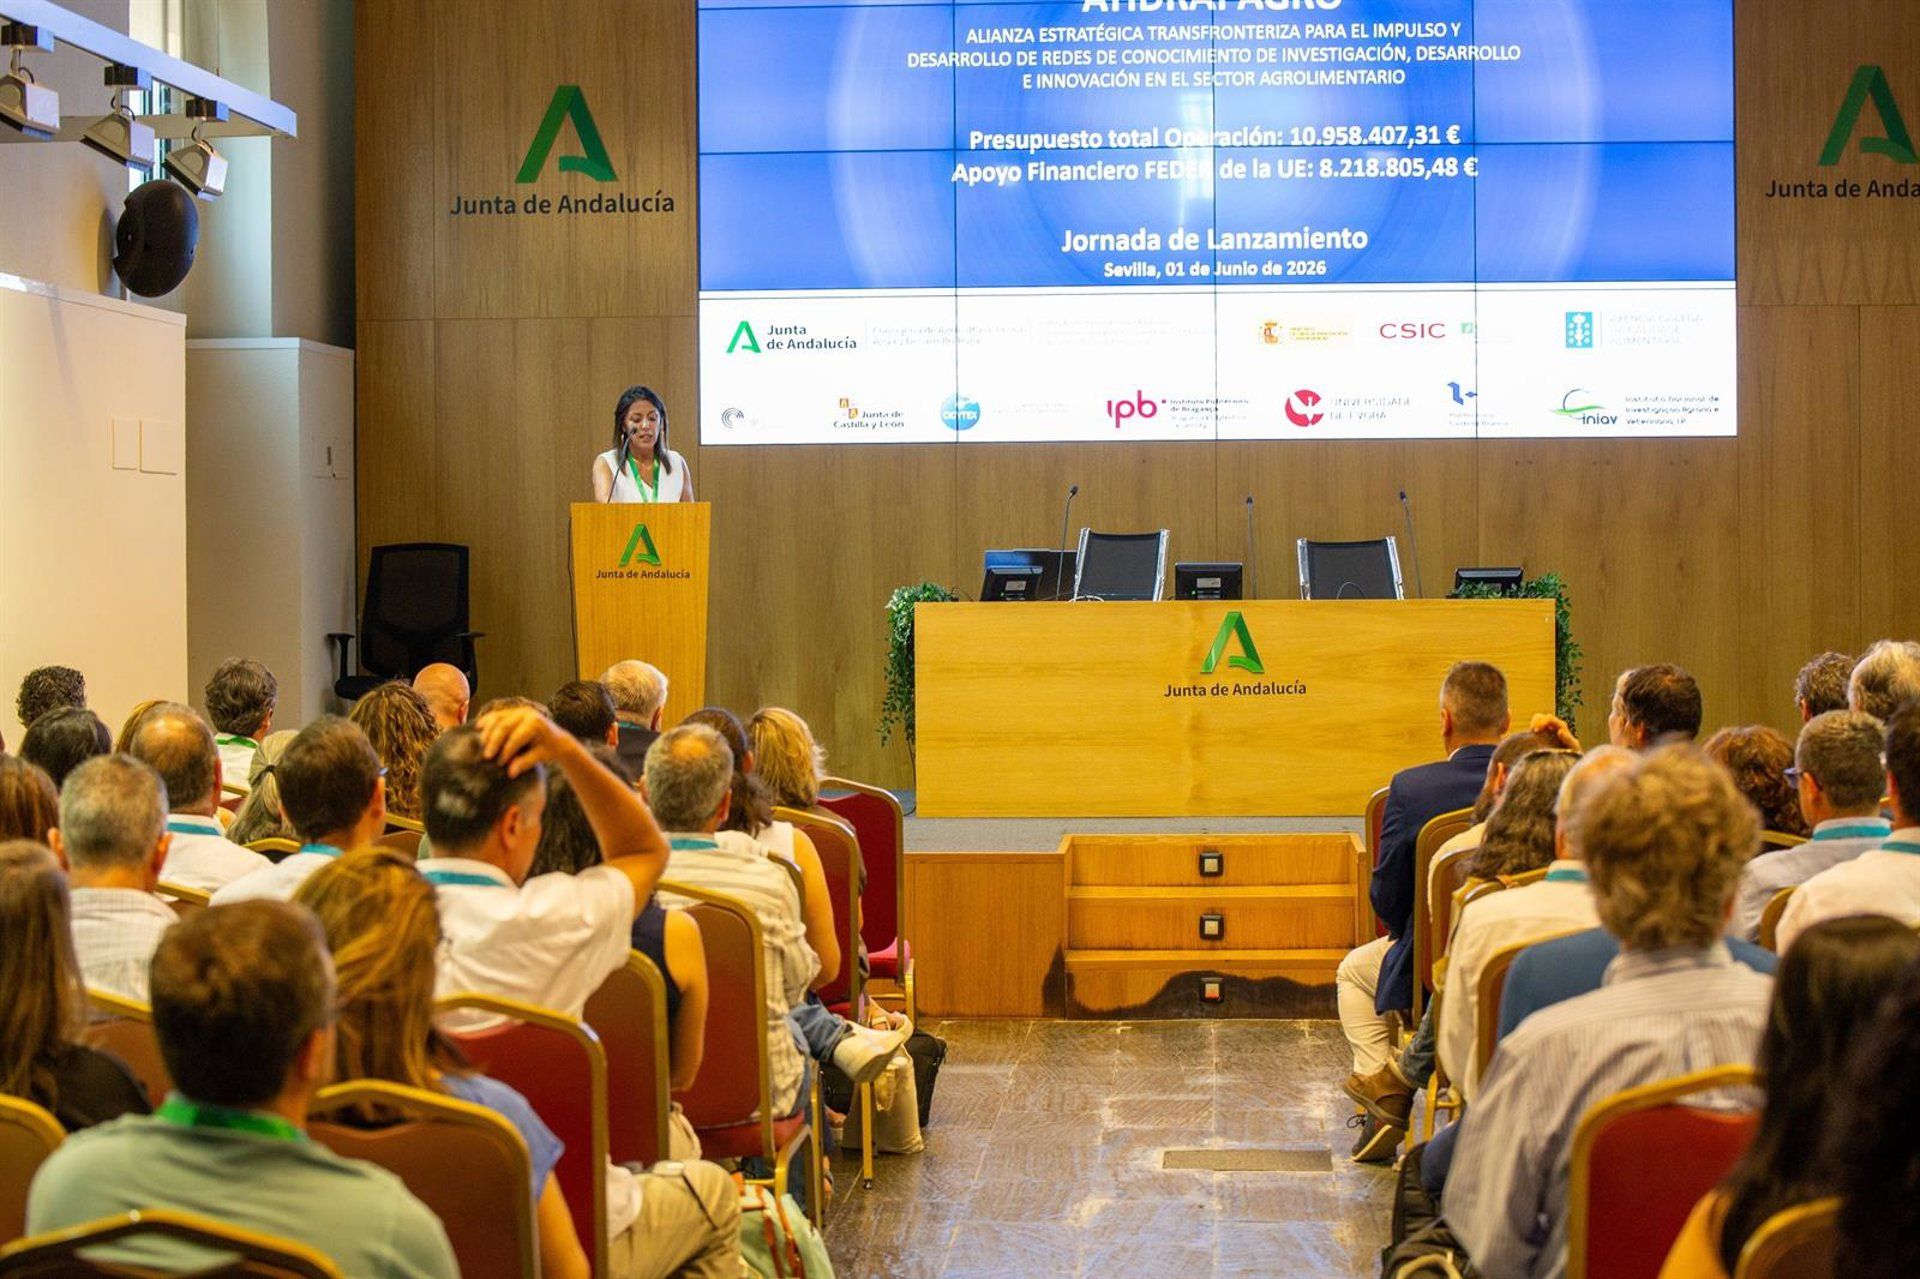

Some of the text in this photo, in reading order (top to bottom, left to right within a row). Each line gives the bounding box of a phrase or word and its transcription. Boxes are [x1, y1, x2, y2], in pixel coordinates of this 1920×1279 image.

[966, 22, 1461, 43] ALIANZA ESTRATÉGICA TRANSFRONTERIZA PARA EL IMPULSO Y
[907, 43, 1521, 68] DESARROLLO DE REDES DE CONOCIMIENTO DE INVESTIGACIÓN, DESARROLLO
[1023, 69, 1406, 89] E INNOVACIÓN EN EL SECTOR AGROLIMENTARIO
[970, 125, 1461, 155] Presupuesto total Operación: 10.958.407,31 €
[951, 162, 1022, 187] Apoyo
[1027, 161, 1139, 181] Financiero
[1219, 158, 1247, 178] de
[1253, 158, 1271, 178] la
[1278, 159, 1314, 178] UE:
[1319, 156, 1459, 180] 8.218.805,48
[1463, 156, 1479, 177] €
[1765, 180, 1828, 198] Junta
[1835, 178, 1861, 198] de
[450, 190, 675, 215] Junta de Andalucía
[1061, 227, 1369, 252] Jornada de Lanzamiento
[1103, 260, 1327, 280] Sevilla, 01 de Junio de 2026
[766, 325, 807, 336] Junta
[1379, 323, 1446, 339] CSIC
[766, 336, 857, 350] de Andalucía
[1107, 389, 1158, 429] ipb
[596, 569, 690, 579] Junta de Andalucía
[1164, 680, 1306, 698] Junta de Andalucía
